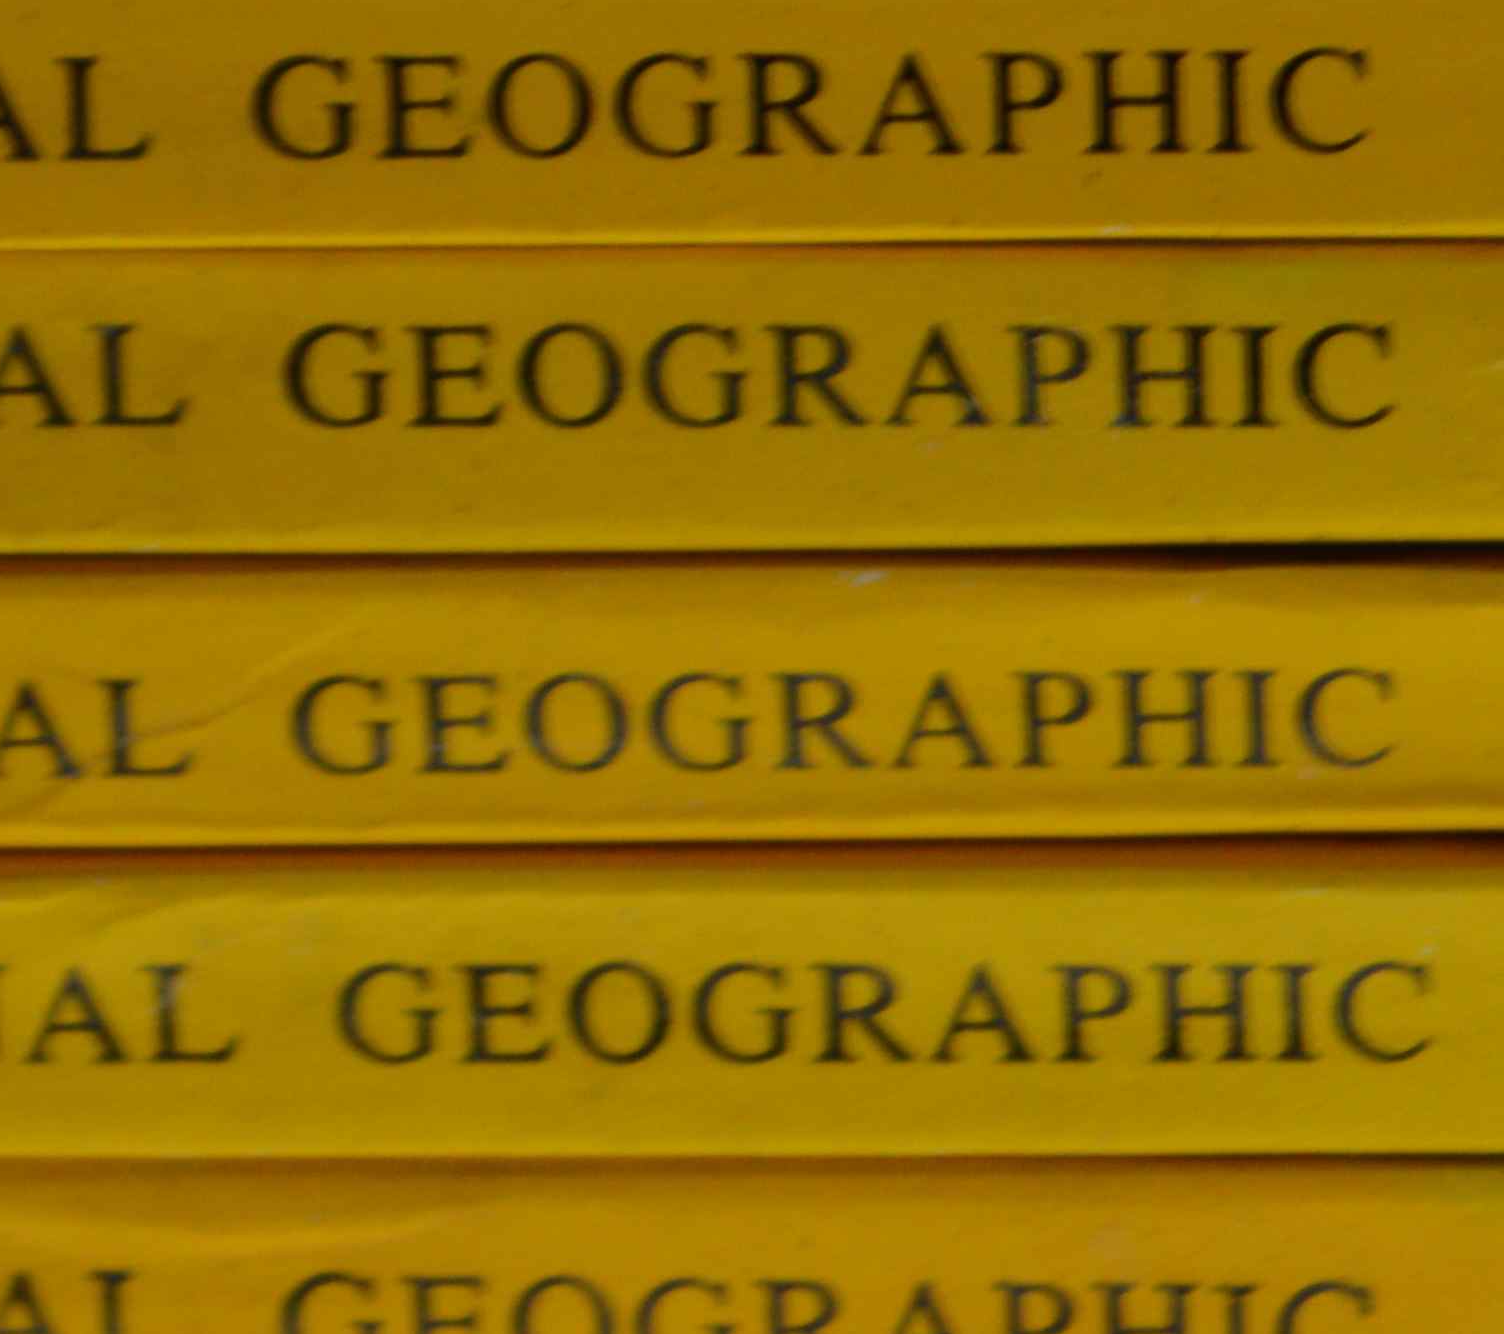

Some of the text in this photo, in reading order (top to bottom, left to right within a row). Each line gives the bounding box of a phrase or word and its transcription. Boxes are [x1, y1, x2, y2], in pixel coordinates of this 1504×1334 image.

[247, 46, 1370, 163] GEOGRAPHIC
[279, 321, 1396, 432] GEOGRAPHIC
[289, 668, 1392, 777] GEOGRAPHIC
[332, 960, 1434, 1068] GEOGRAPHIC
